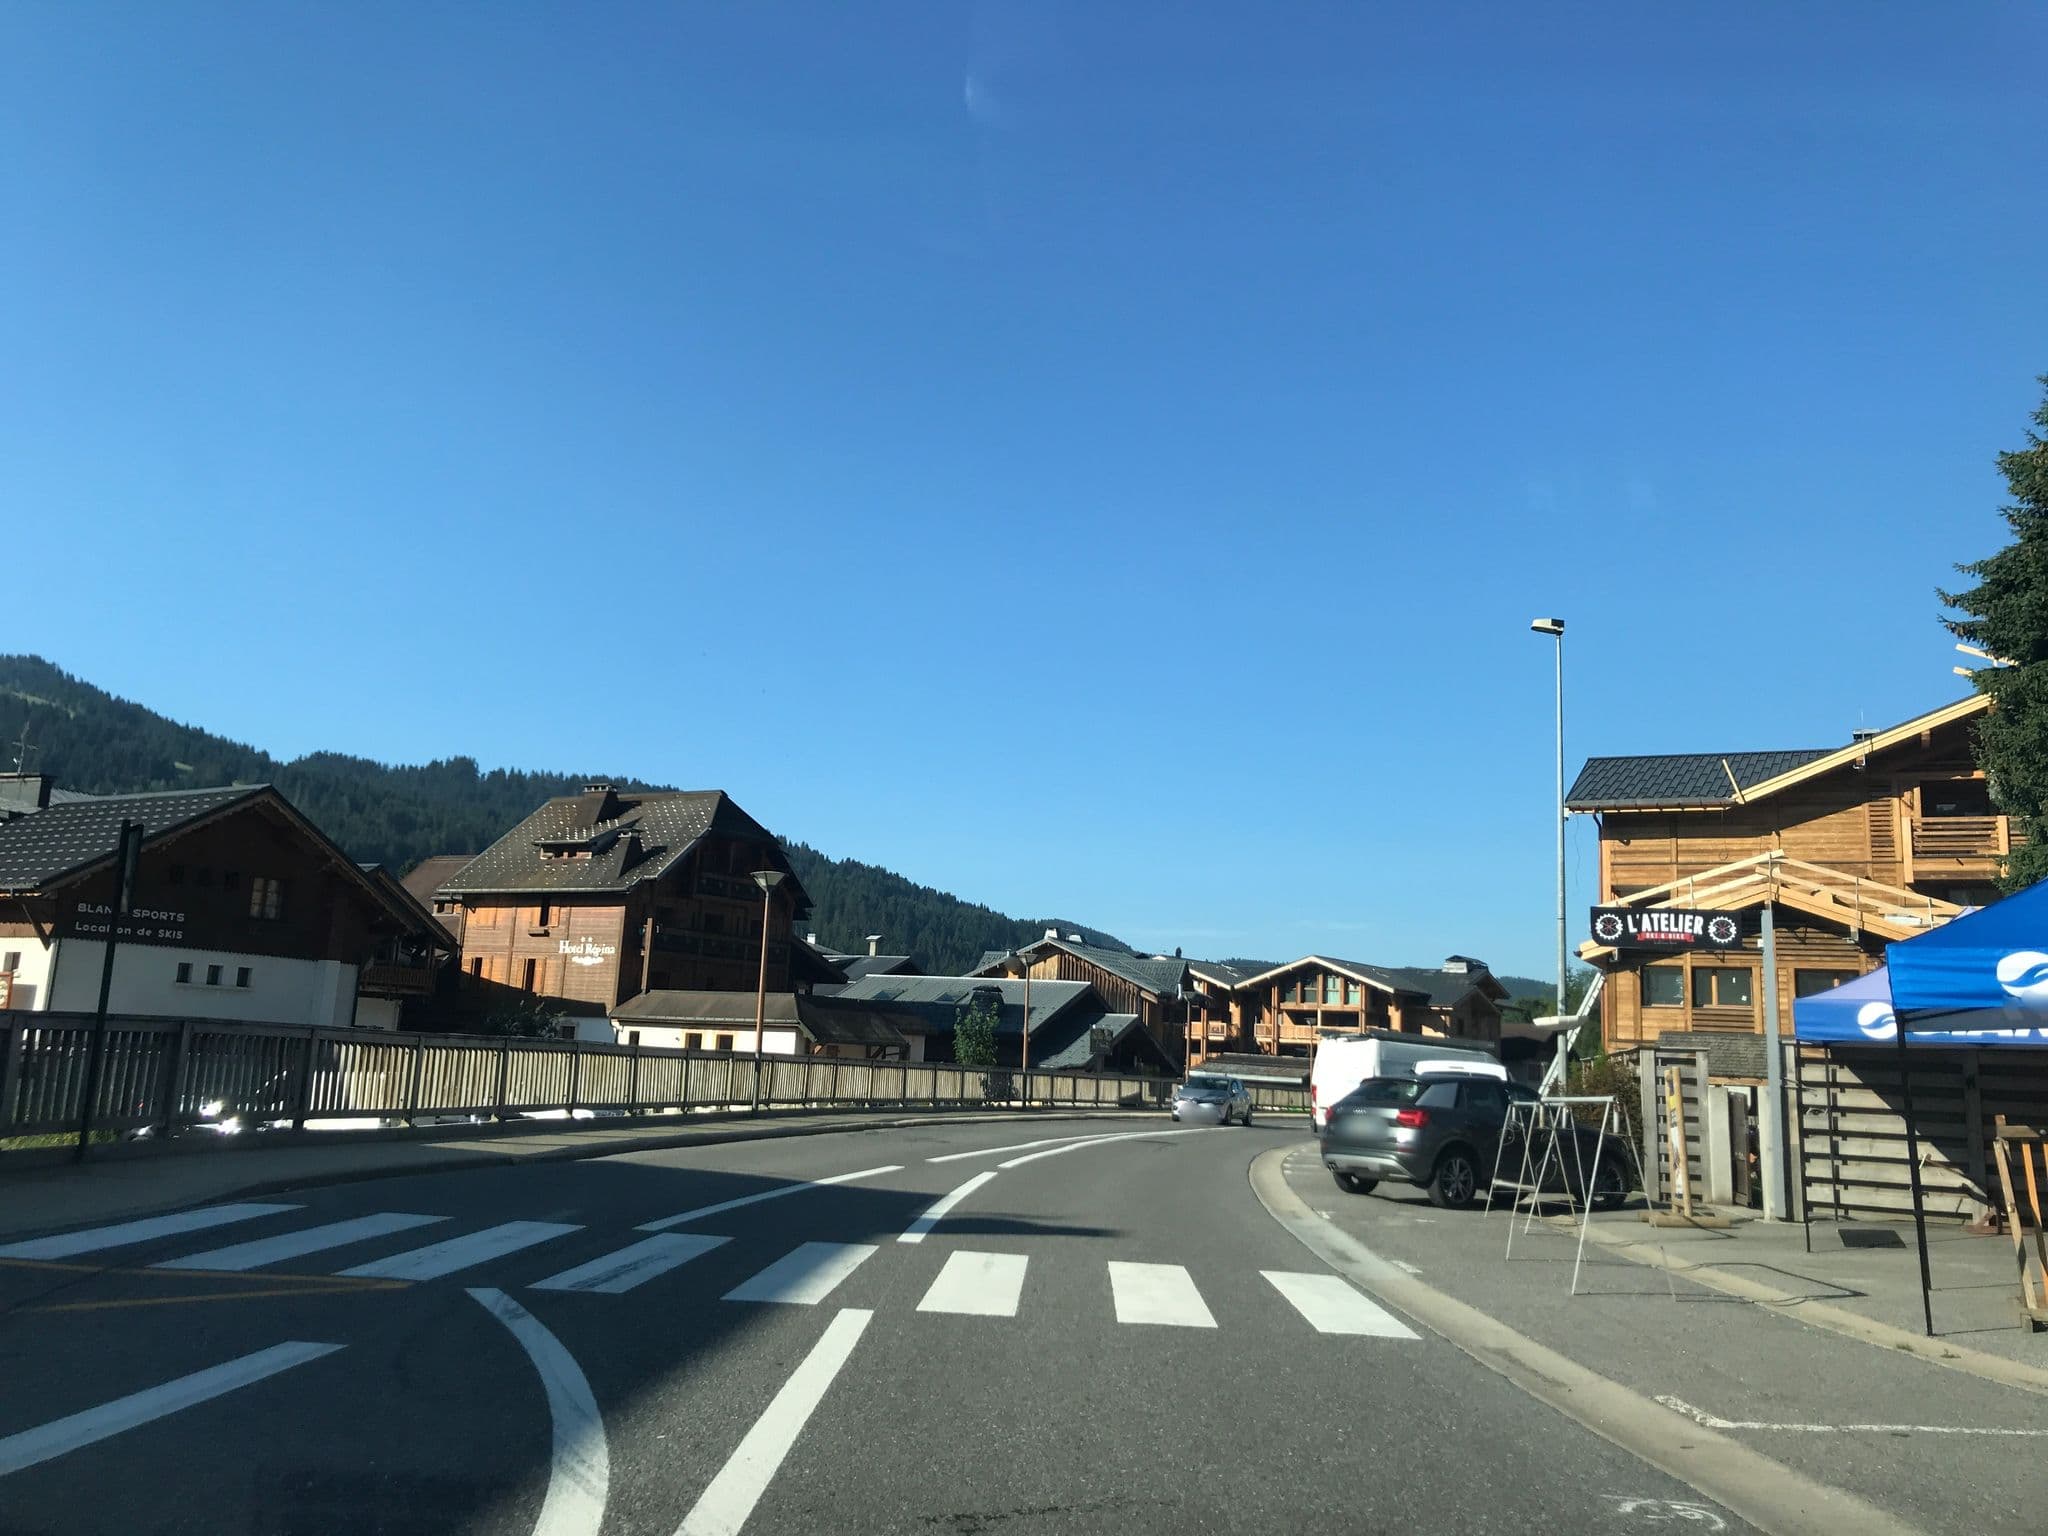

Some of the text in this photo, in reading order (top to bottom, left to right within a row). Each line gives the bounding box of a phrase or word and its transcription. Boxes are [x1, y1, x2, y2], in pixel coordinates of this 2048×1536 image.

[77, 902, 185, 922] BLAN SPORTS
[1626, 912, 1704, 935] L'ATELIER
[137, 928, 152, 937] de
[158, 929, 183, 940] SKIS
